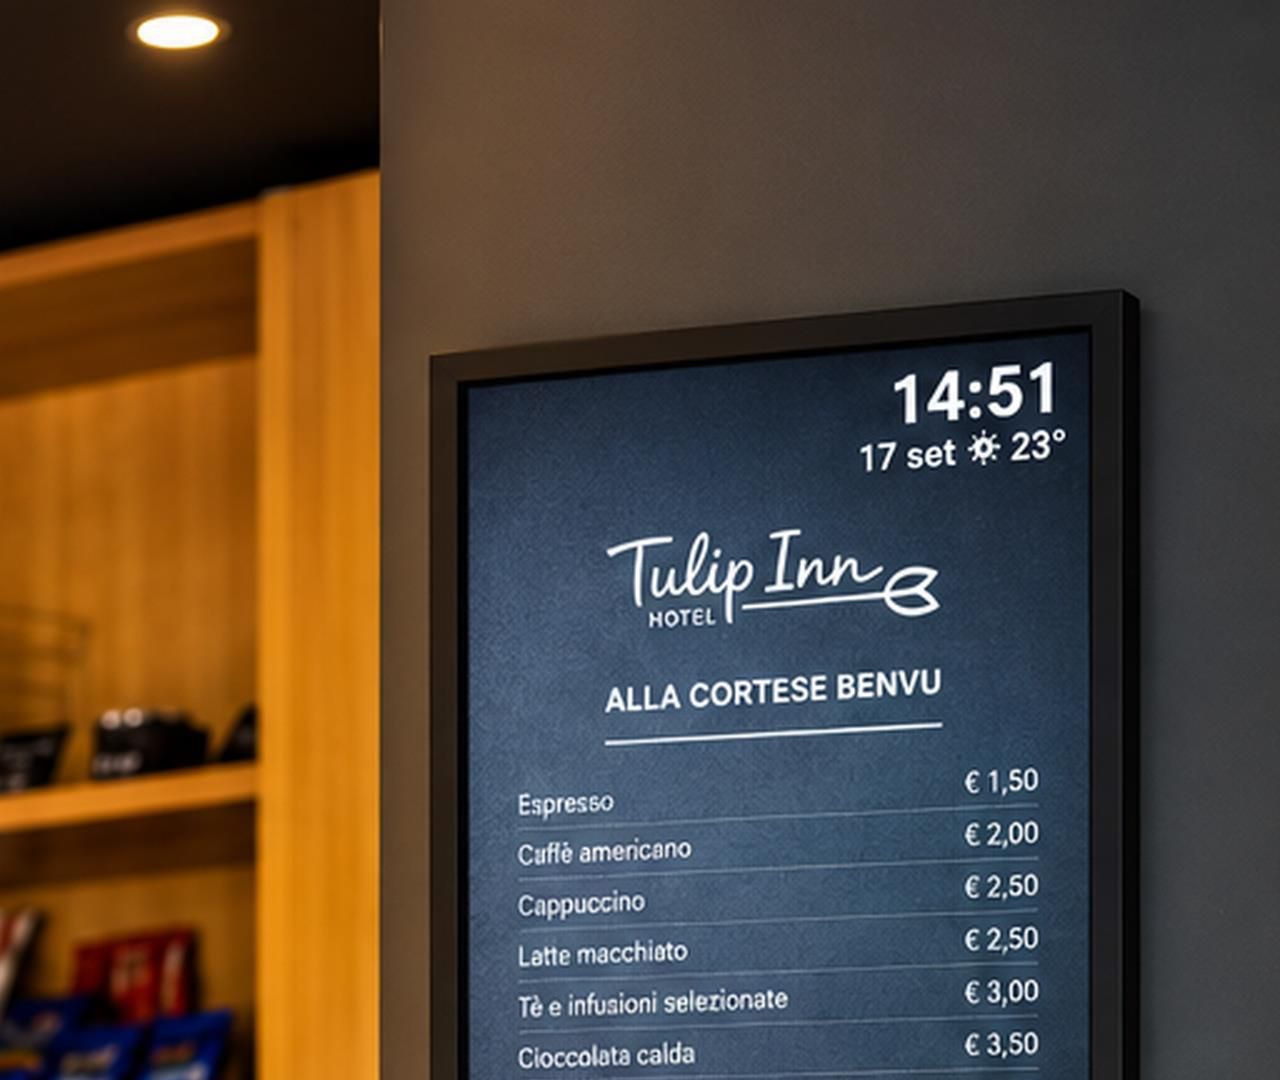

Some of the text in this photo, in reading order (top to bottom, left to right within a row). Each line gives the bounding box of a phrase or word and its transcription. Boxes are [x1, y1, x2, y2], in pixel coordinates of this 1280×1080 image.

[893, 361, 1053, 424] 14:51
[859, 428, 1066, 472] 17 set 23°
[606, 528, 884, 625] Tulip Inn
[648, 607, 716, 629] HOTEL
[604, 668, 942, 713] ALLA CORTESE BENVU
[519, 768, 1039, 820] Espresso € 1,50
[580, 838, 692, 863] americano
[964, 822, 981, 847] €
[986, 821, 1039, 849] 2,00
[519, 873, 1039, 920] Cappuccino € 2,50
[519, 926, 1039, 967] Latte macchiato € 2,50
[519, 979, 1039, 1018] Tè e infusioni selezionate € 3,00
[519, 1032, 1039, 1069] Cioccolata calda € 3,50
